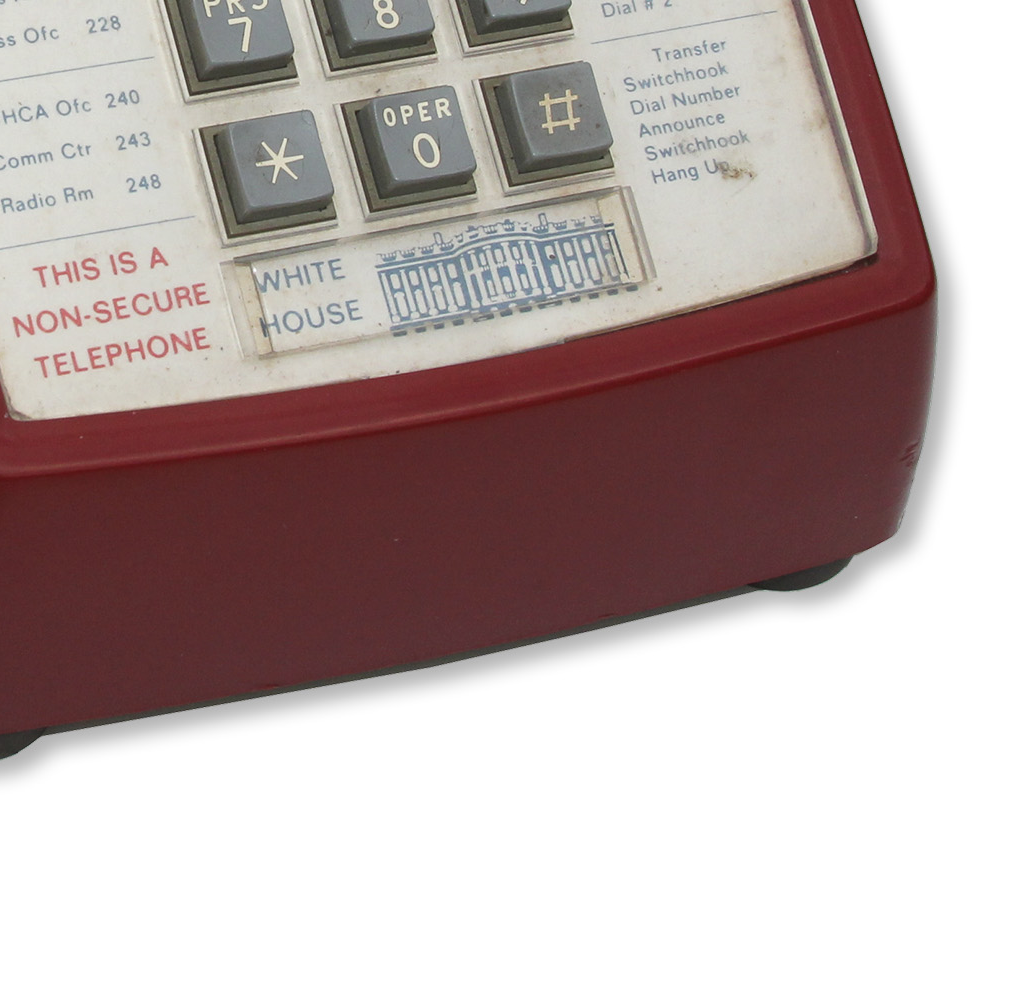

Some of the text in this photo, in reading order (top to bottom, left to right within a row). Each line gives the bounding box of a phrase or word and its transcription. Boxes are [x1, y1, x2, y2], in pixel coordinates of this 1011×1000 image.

[601, 0, 637, 18] Dial
[24, 27, 59, 43] Ofc
[86, 16, 121, 34] 228
[228, 17, 252, 52] 7
[652, 40, 727, 63] Transfer
[623, 63, 728, 92] Switchhook
[56, 99, 91, 116] Ofc
[106, 90, 140, 108] 240
[382, 98, 452, 127] OPER
[538, 89, 580, 134] #
[630, 85, 740, 115] Dial Number
[639, 111, 725, 138] Announce
[61, 143, 91, 159] Ctr
[116, 132, 151, 150] 243
[412, 132, 441, 168] 0
[645, 131, 750, 161] Switchhook
[651, 161, 699, 184] Hang
[1, 174, 161, 214] Radio Rm 248
[33, 247, 169, 288] THIS IS A
[257, 258, 346, 292] WHITE
[12, 284, 210, 338] NON-SECURE
[258, 300, 363, 337] HOUSE
[34, 328, 210, 379] TELEPHONE
